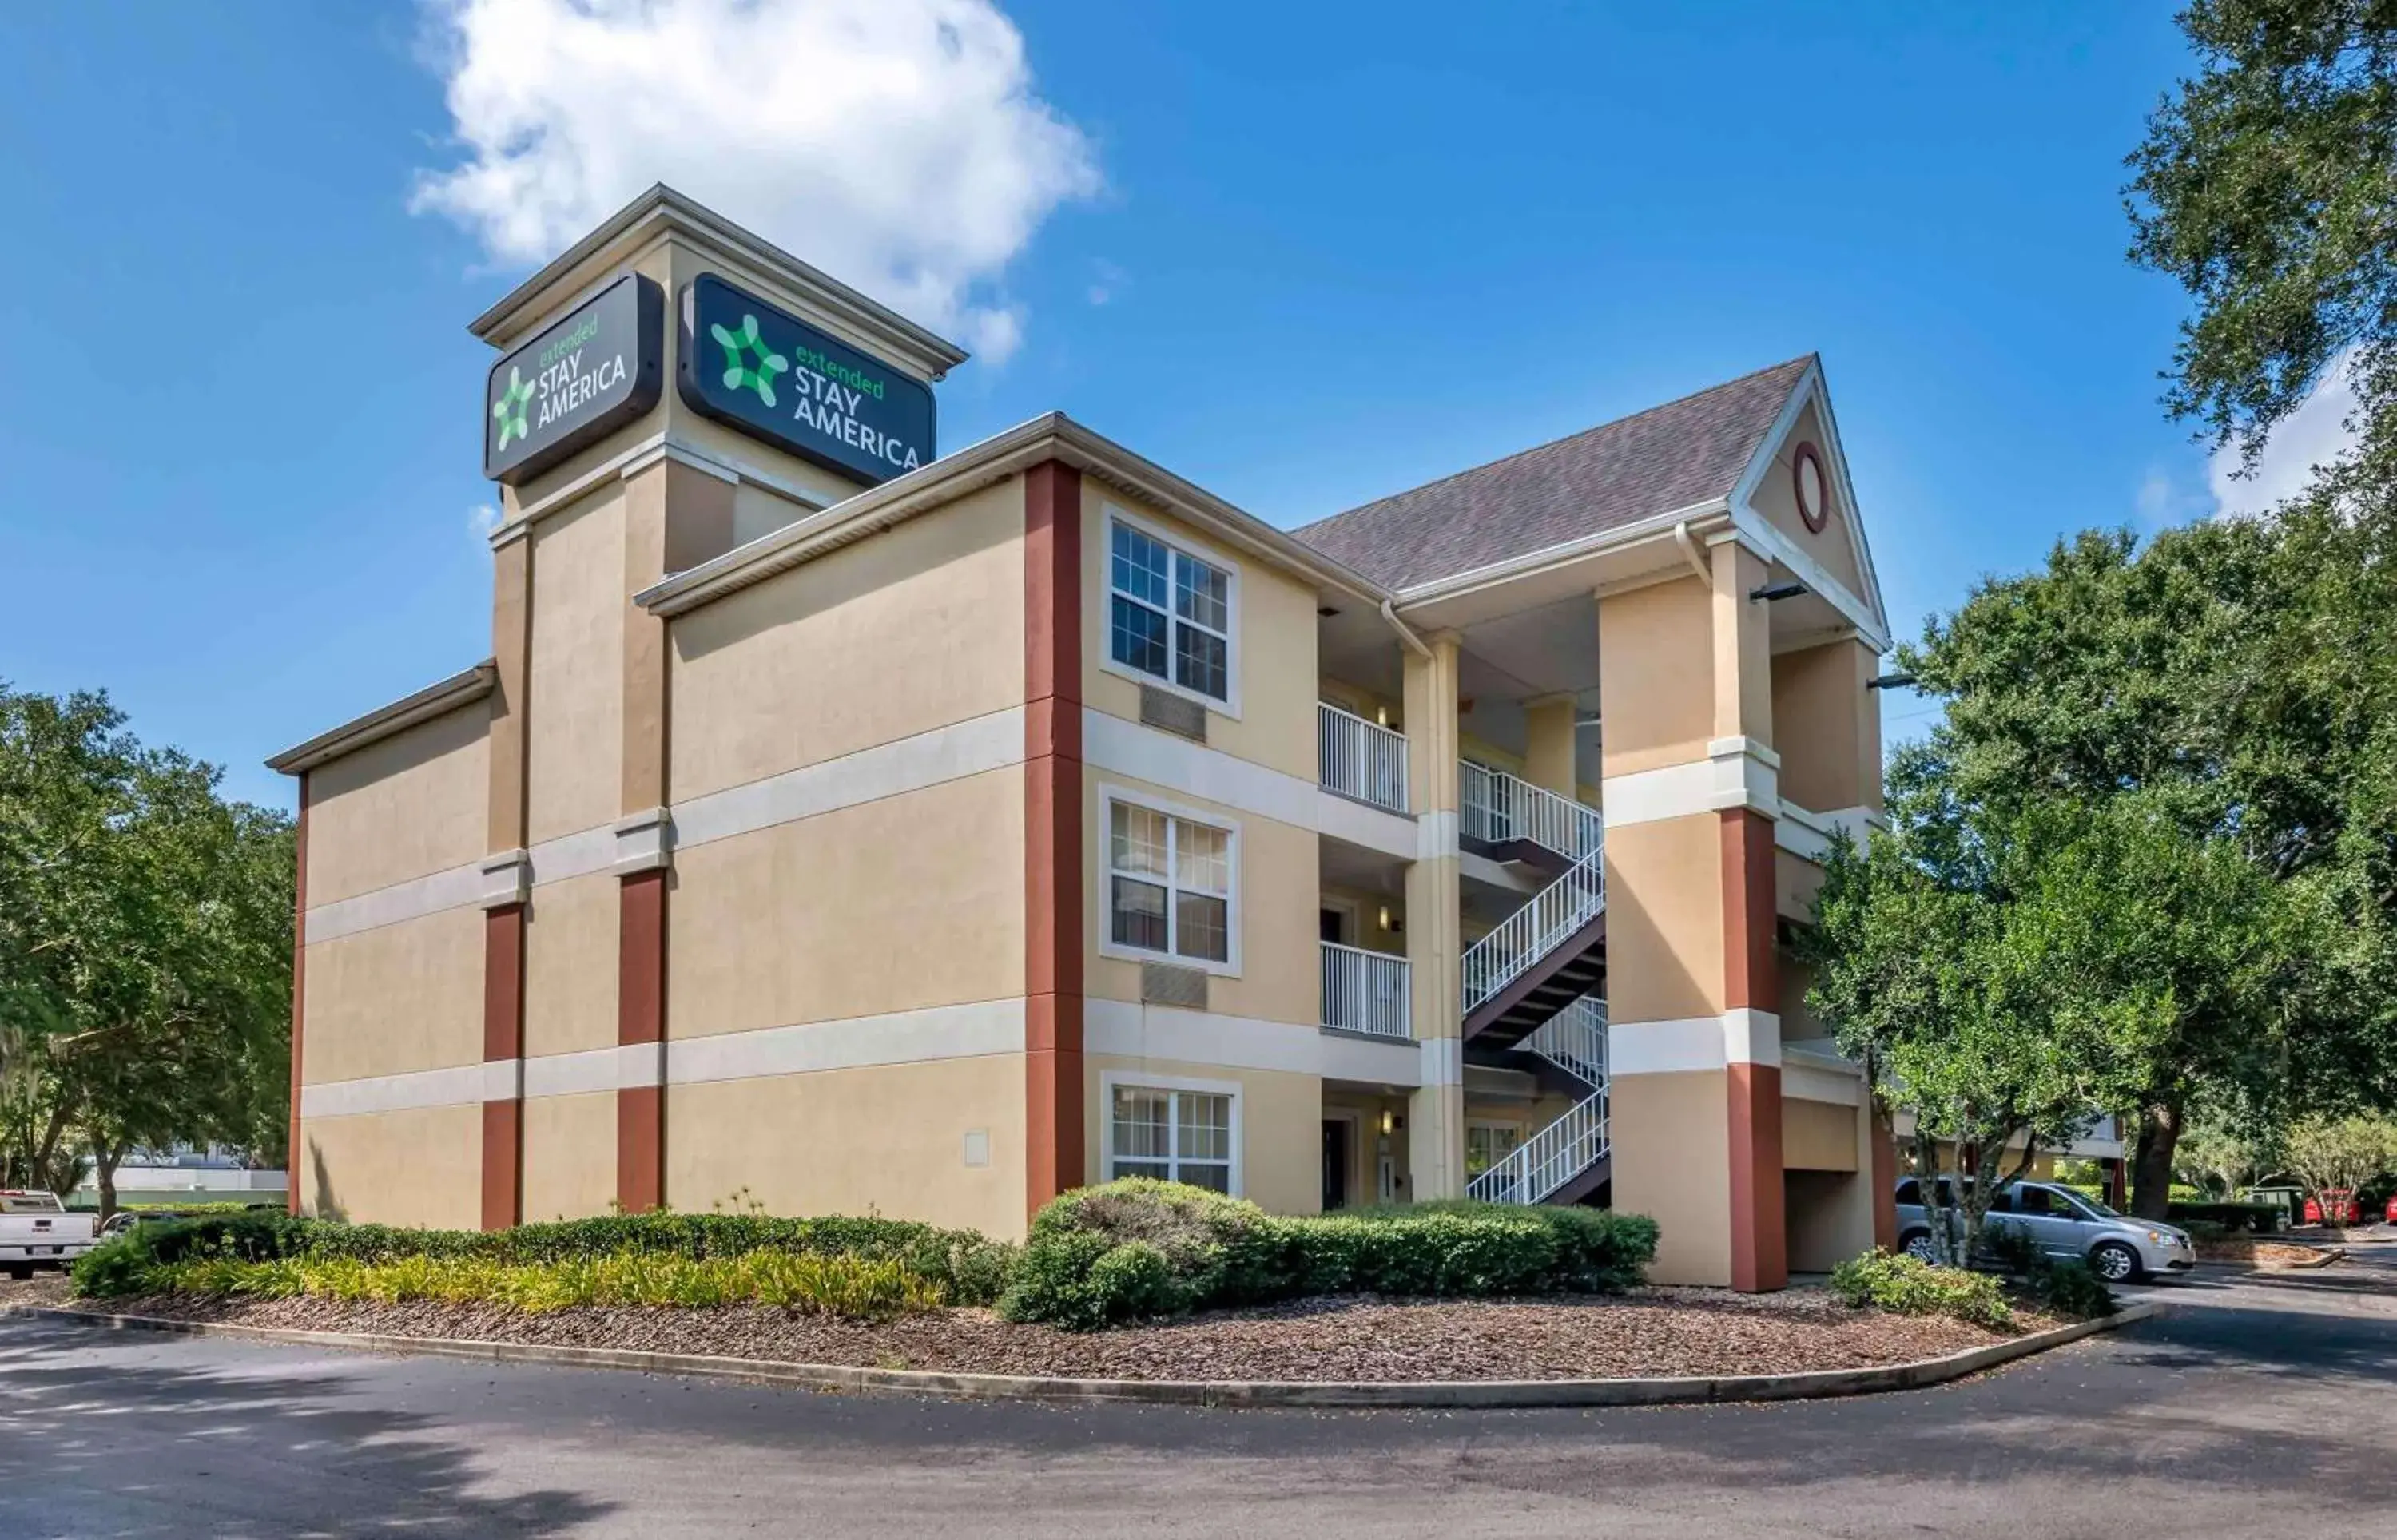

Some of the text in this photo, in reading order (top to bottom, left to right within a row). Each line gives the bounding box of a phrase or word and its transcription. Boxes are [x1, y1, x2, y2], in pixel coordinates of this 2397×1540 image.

[540, 313, 598, 367] extended
[537, 354, 626, 430] AMERICA
[539, 348, 582, 399] STAY
[795, 367, 861, 416] STAY
[796, 346, 884, 399] extended
[793, 398, 919, 470] AMERICA
